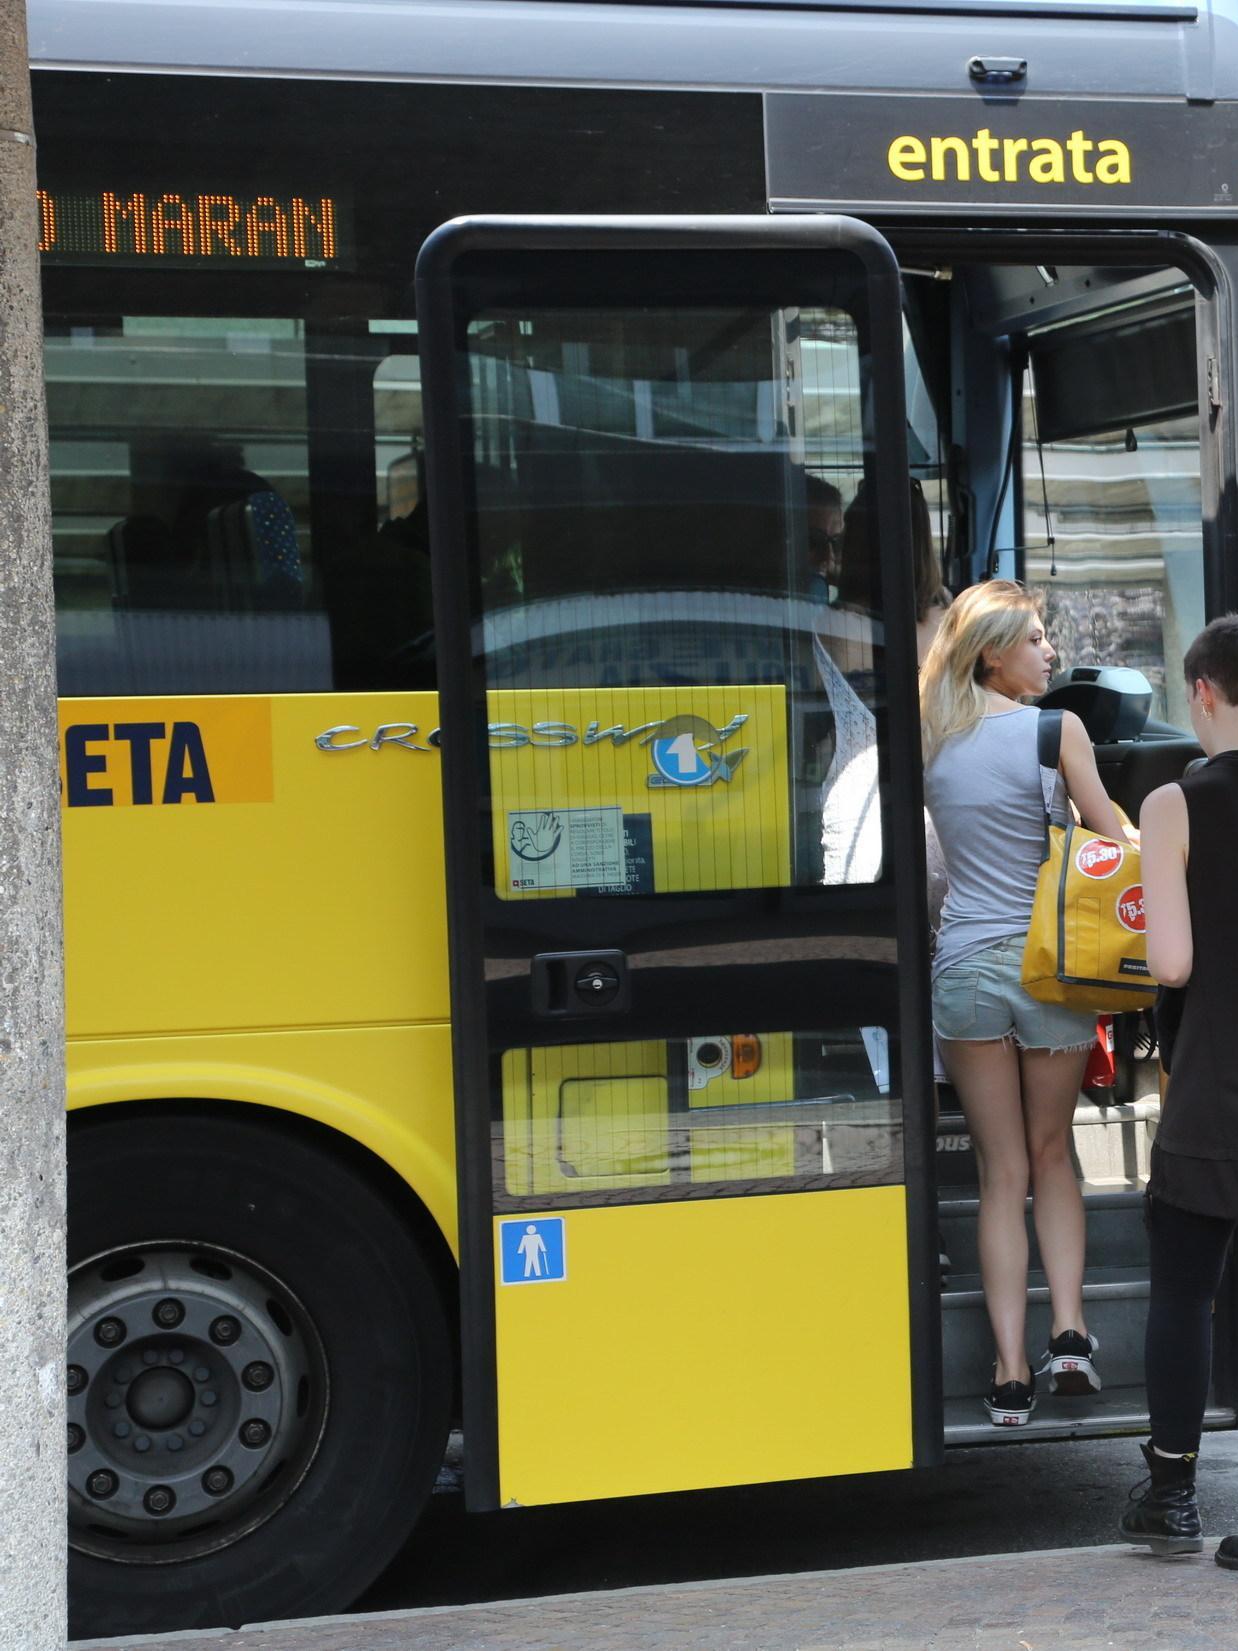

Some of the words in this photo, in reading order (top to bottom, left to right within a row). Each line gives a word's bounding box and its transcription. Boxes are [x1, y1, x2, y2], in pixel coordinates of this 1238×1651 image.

[887, 128, 1132, 185] entrata
[103, 192, 335, 258] MARAN
[61, 721, 216, 808] ETA
